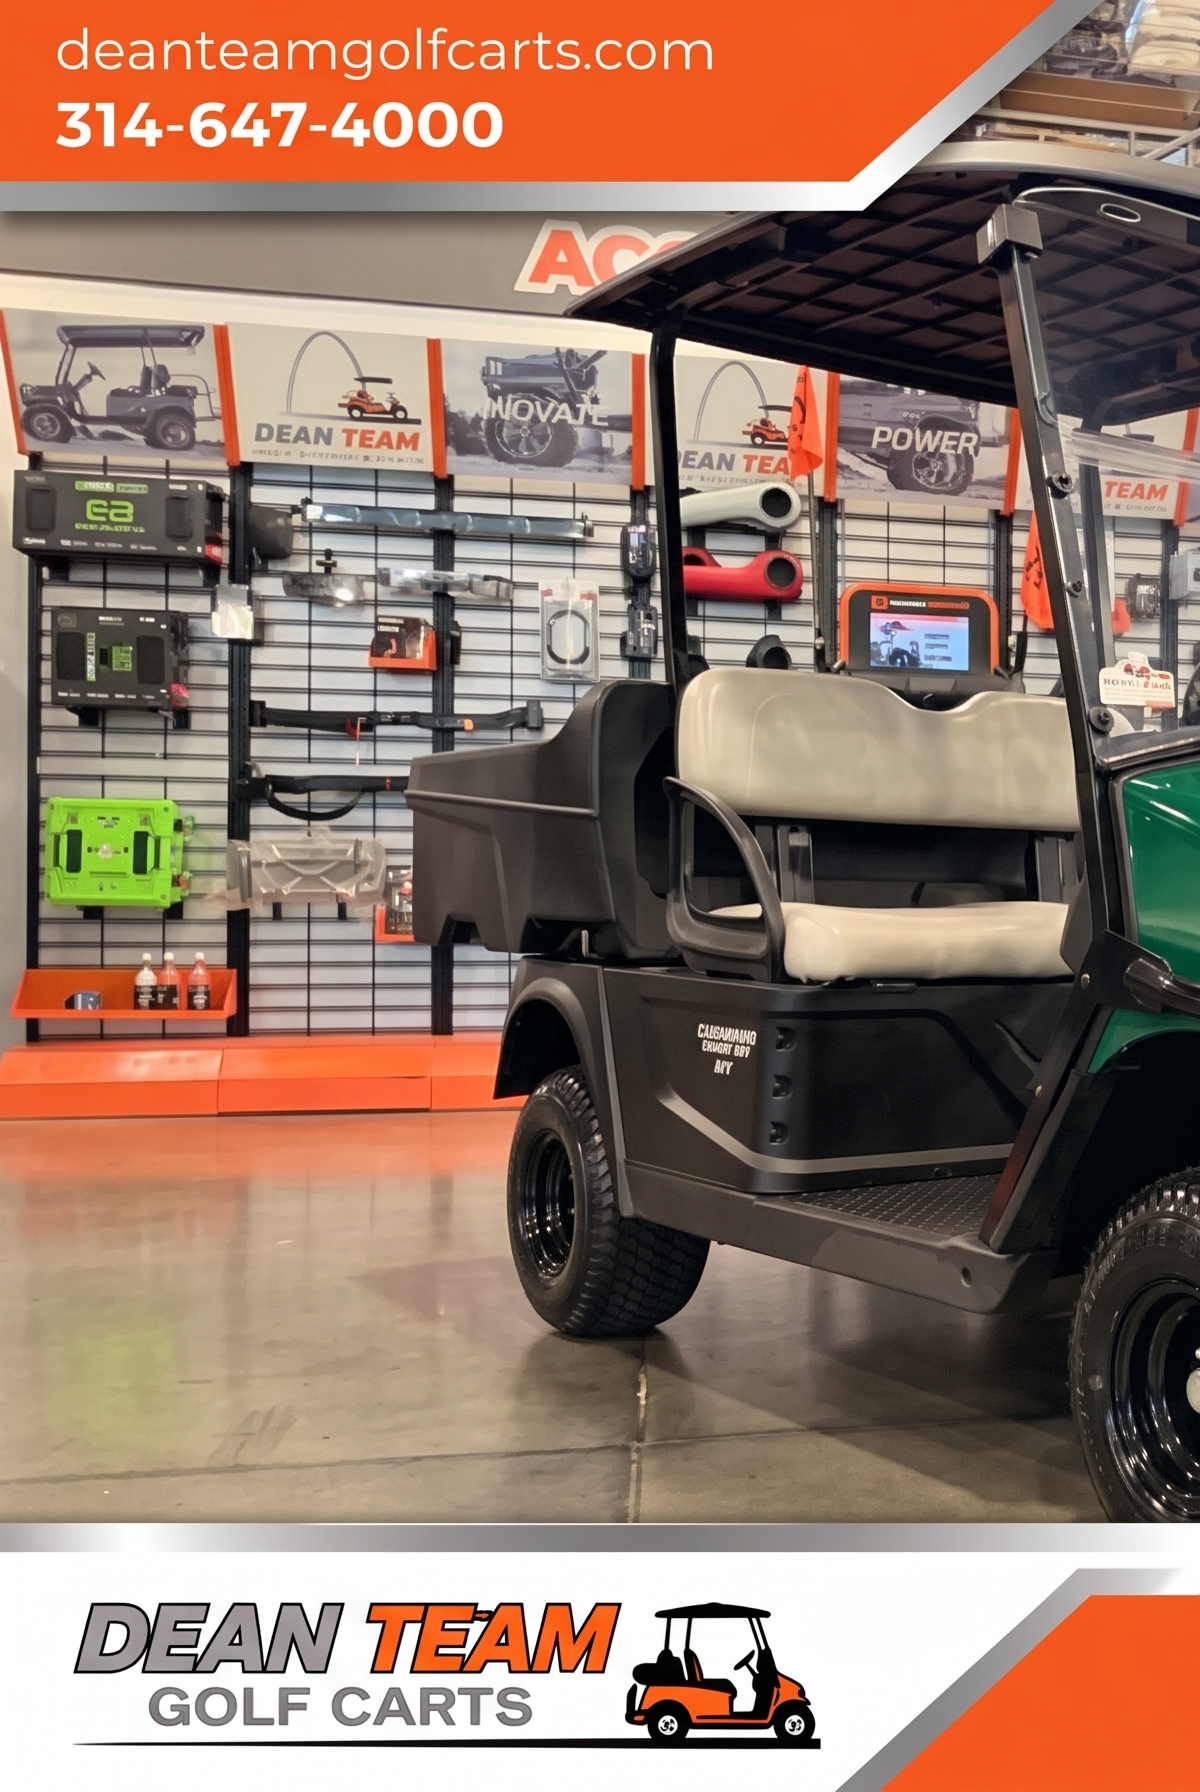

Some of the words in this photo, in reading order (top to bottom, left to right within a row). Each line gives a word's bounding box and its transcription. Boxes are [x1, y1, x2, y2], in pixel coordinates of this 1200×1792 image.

[521, 225, 692, 291] AC
[254, 422, 334, 447] DEAN
[341, 427, 421, 452] TEAM
[871, 425, 979, 456] POWER
[678, 449, 736, 472] EAN
[742, 453, 790, 476] TEA
[1104, 480, 1169, 502] TEAM
